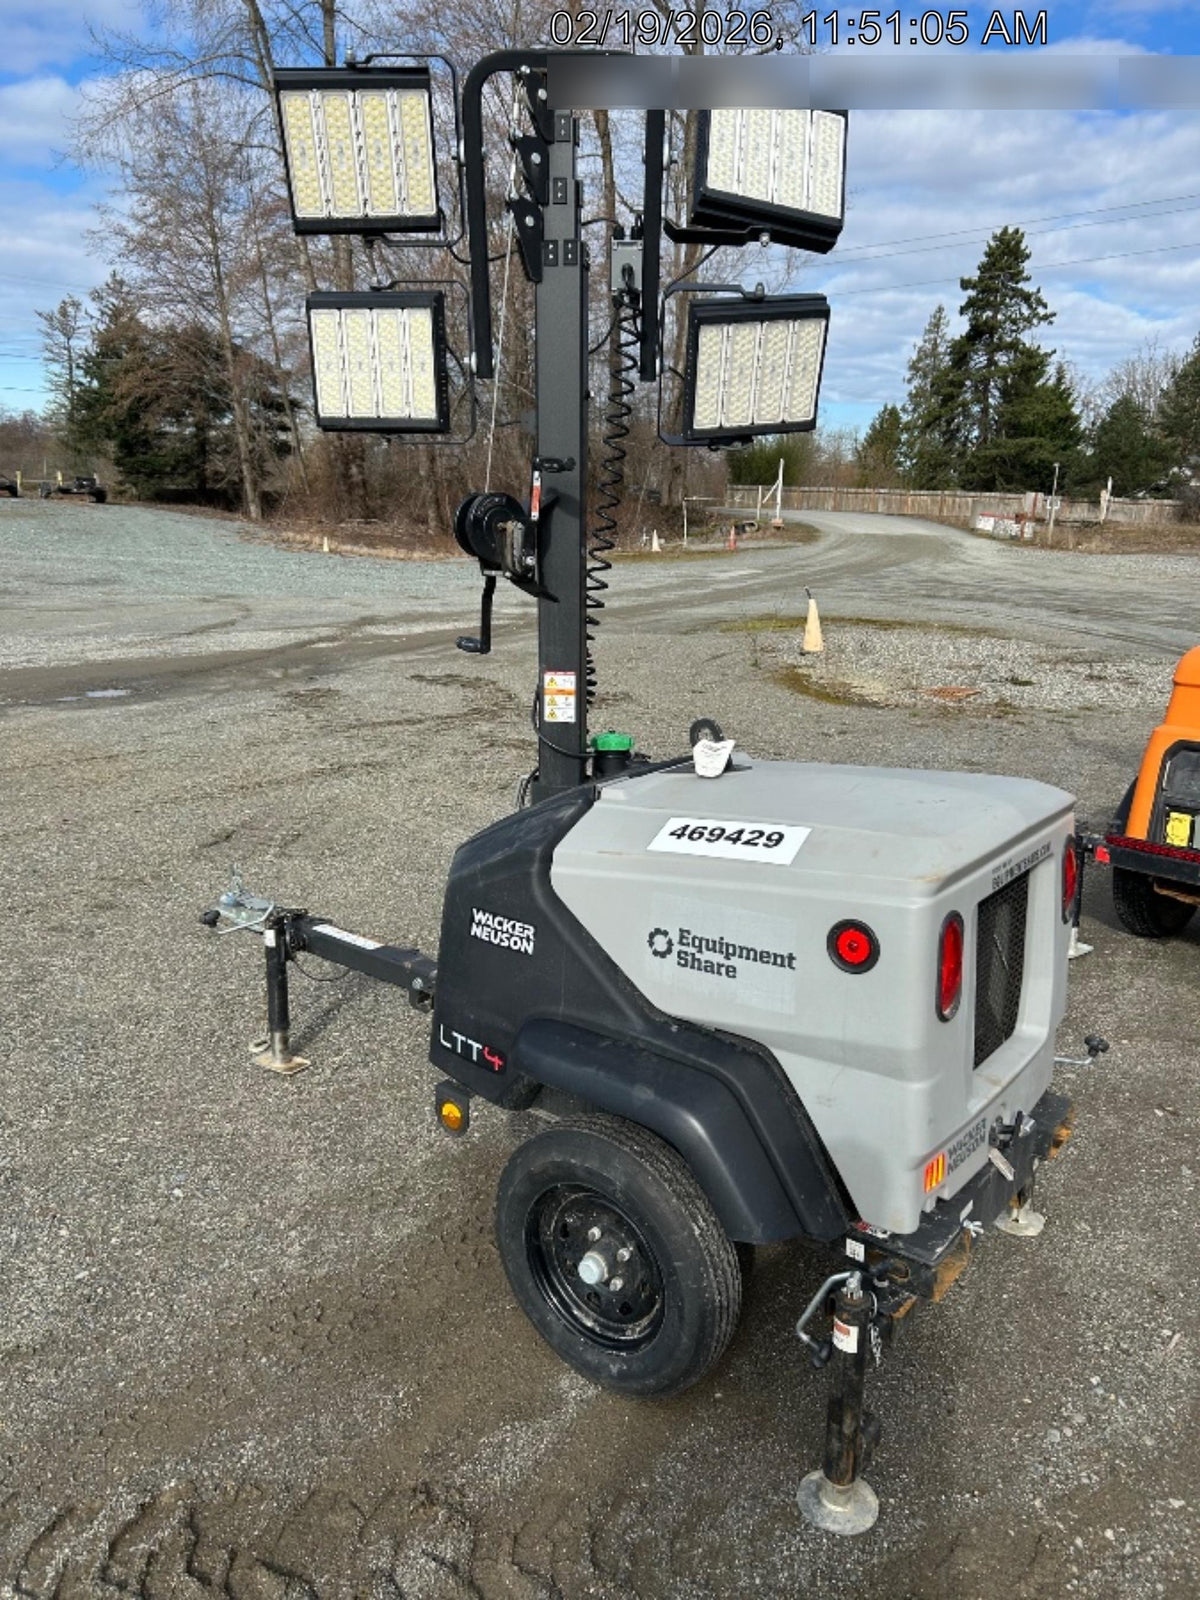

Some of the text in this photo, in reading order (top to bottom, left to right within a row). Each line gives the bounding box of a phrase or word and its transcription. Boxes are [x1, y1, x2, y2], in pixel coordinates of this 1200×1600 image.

[668, 824, 785, 848] 469429
[470, 921, 535, 956] NEUSON
[472, 907, 535, 941] WACKER
[676, 949, 737, 979] Share
[677, 928, 797, 970] Equipment
[439, 1024, 503, 1071] LTT4
